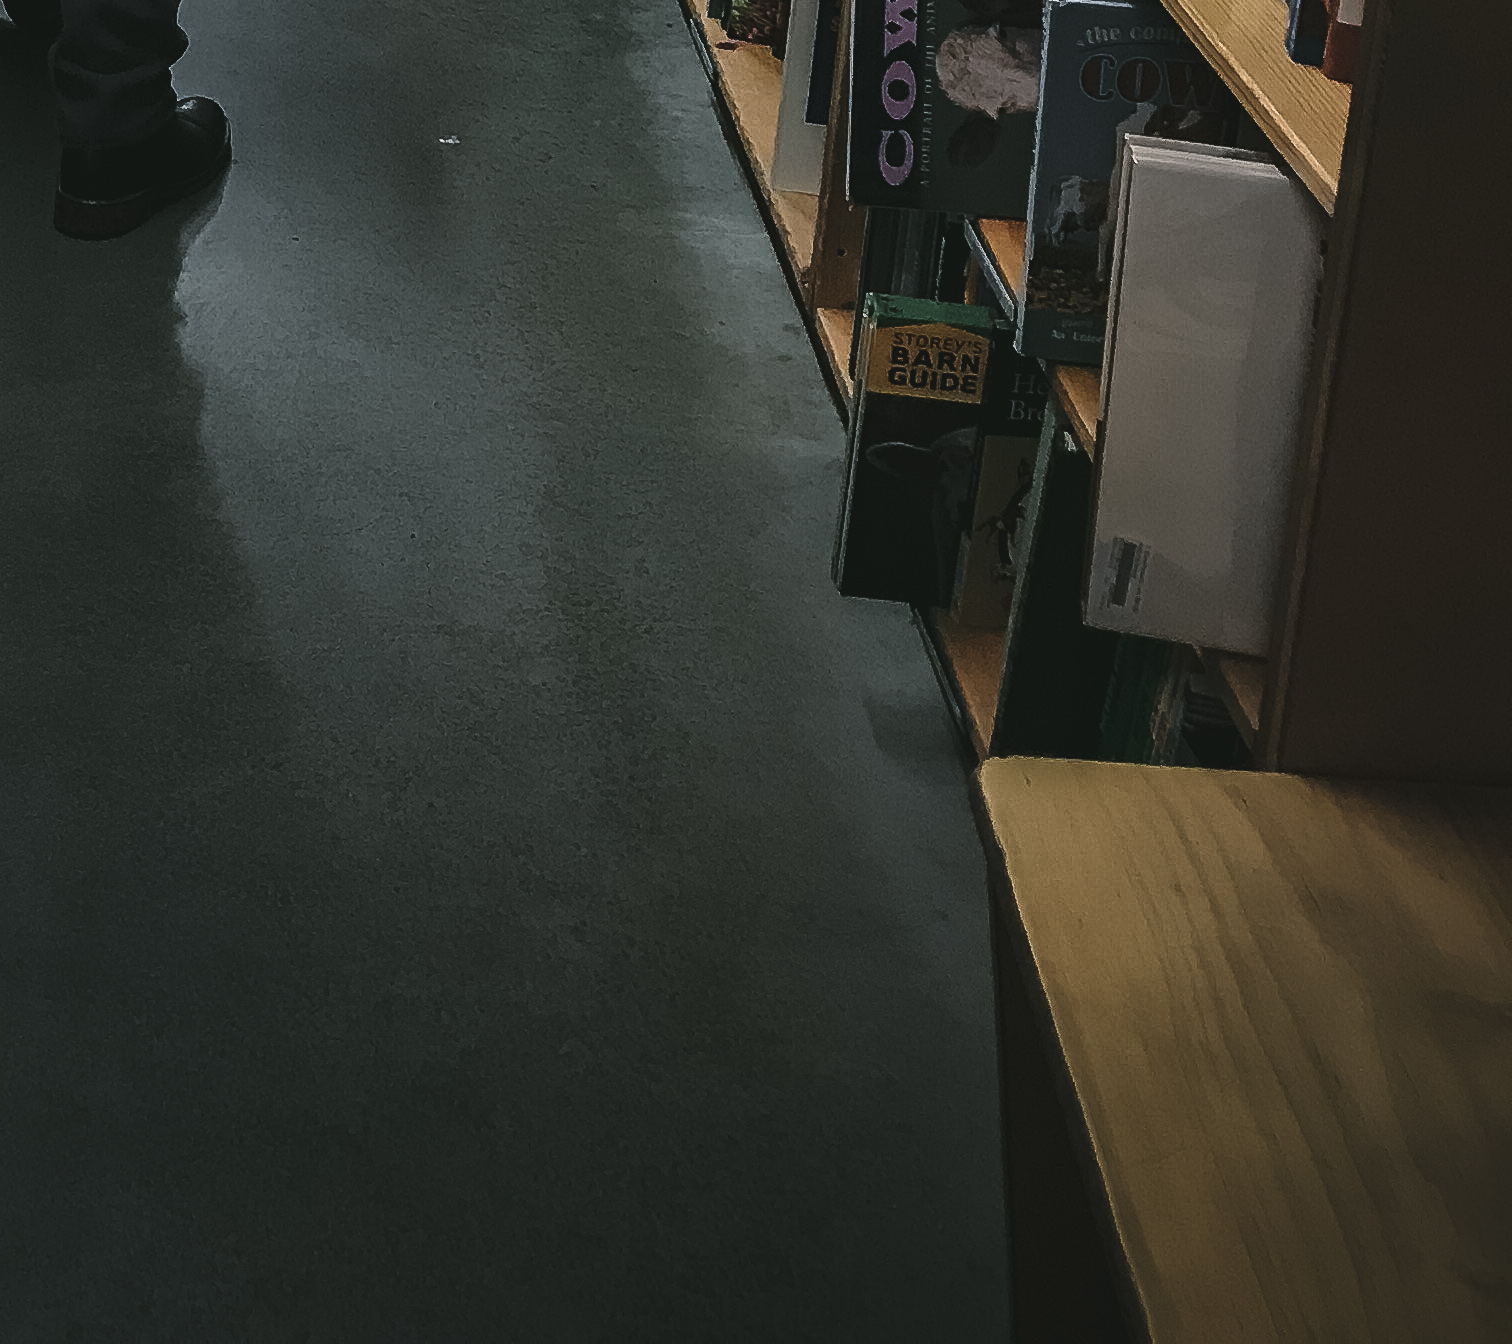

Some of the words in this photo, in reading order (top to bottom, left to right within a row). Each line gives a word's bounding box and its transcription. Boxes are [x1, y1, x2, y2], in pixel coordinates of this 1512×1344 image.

[1086, 26, 1122, 44] the
[925, 44, 936, 69] THE
[924, 78, 934, 95] OF
[920, 102, 934, 174] PORTRAIT
[920, 180, 930, 189] A
[892, 332, 983, 355] STOREY'S
[891, 346, 980, 375] BARN
[888, 367, 978, 395] GUIDE
